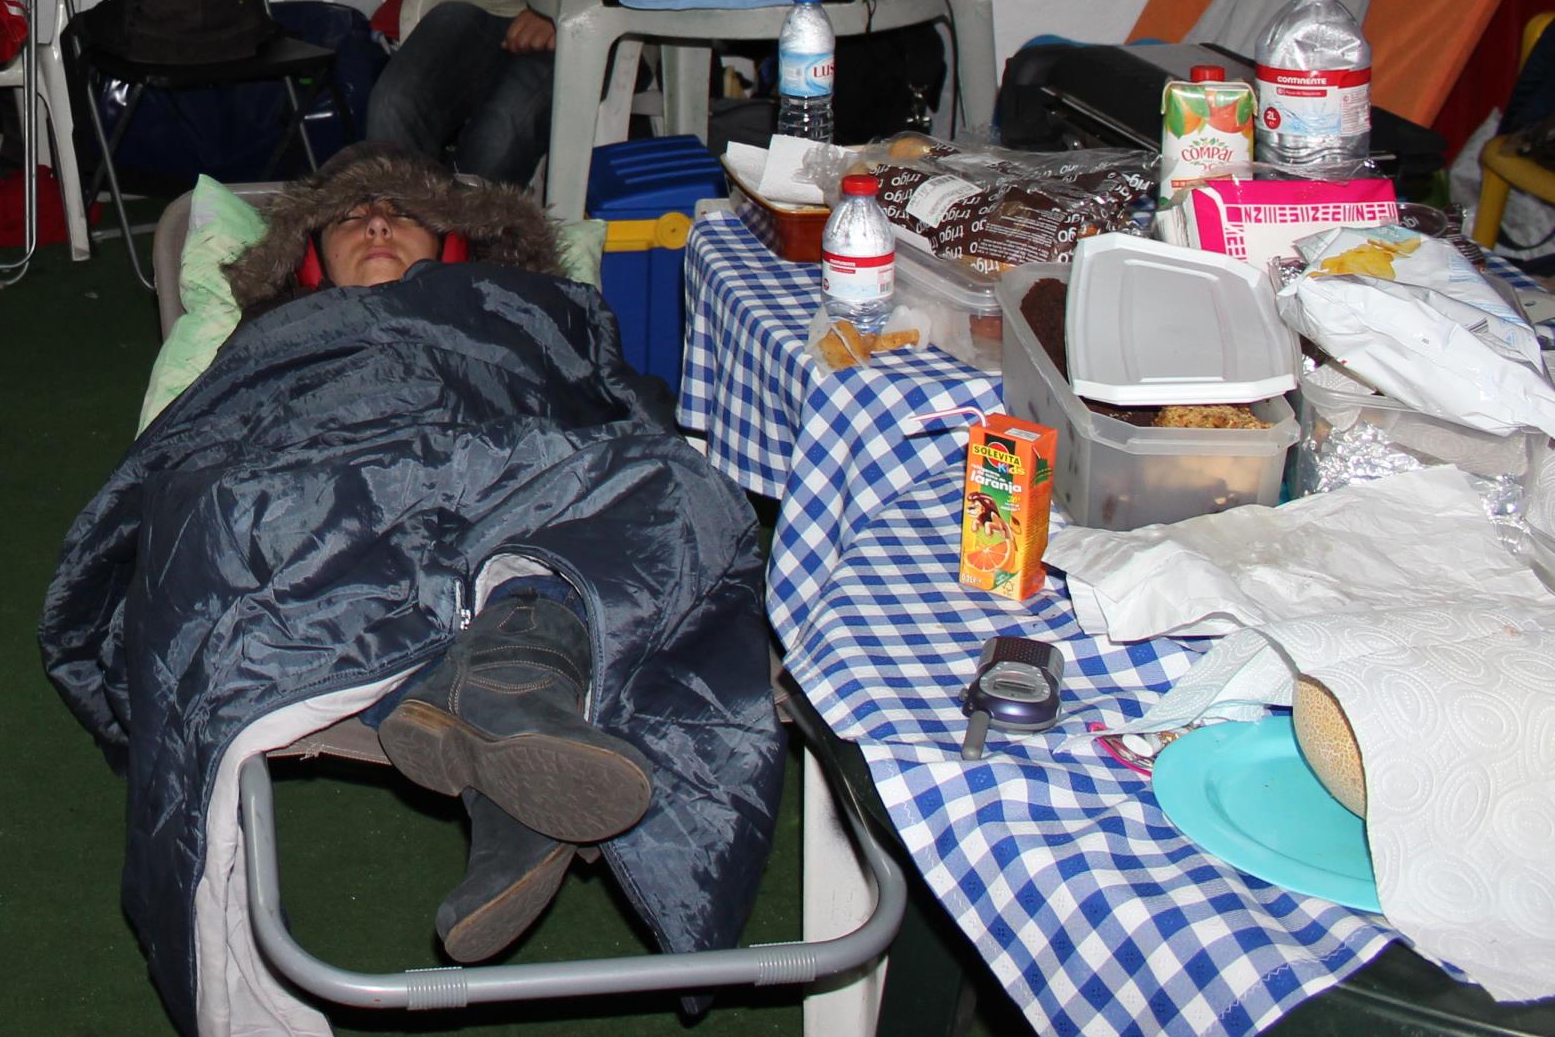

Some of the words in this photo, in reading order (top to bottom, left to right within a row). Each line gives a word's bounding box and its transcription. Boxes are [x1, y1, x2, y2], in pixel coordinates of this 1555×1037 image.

[939, 224, 965, 243] trigo
[973, 445, 1021, 466] SOLEVITA
[997, 462, 1026, 476] Kids
[970, 471, 1022, 494] laranja
